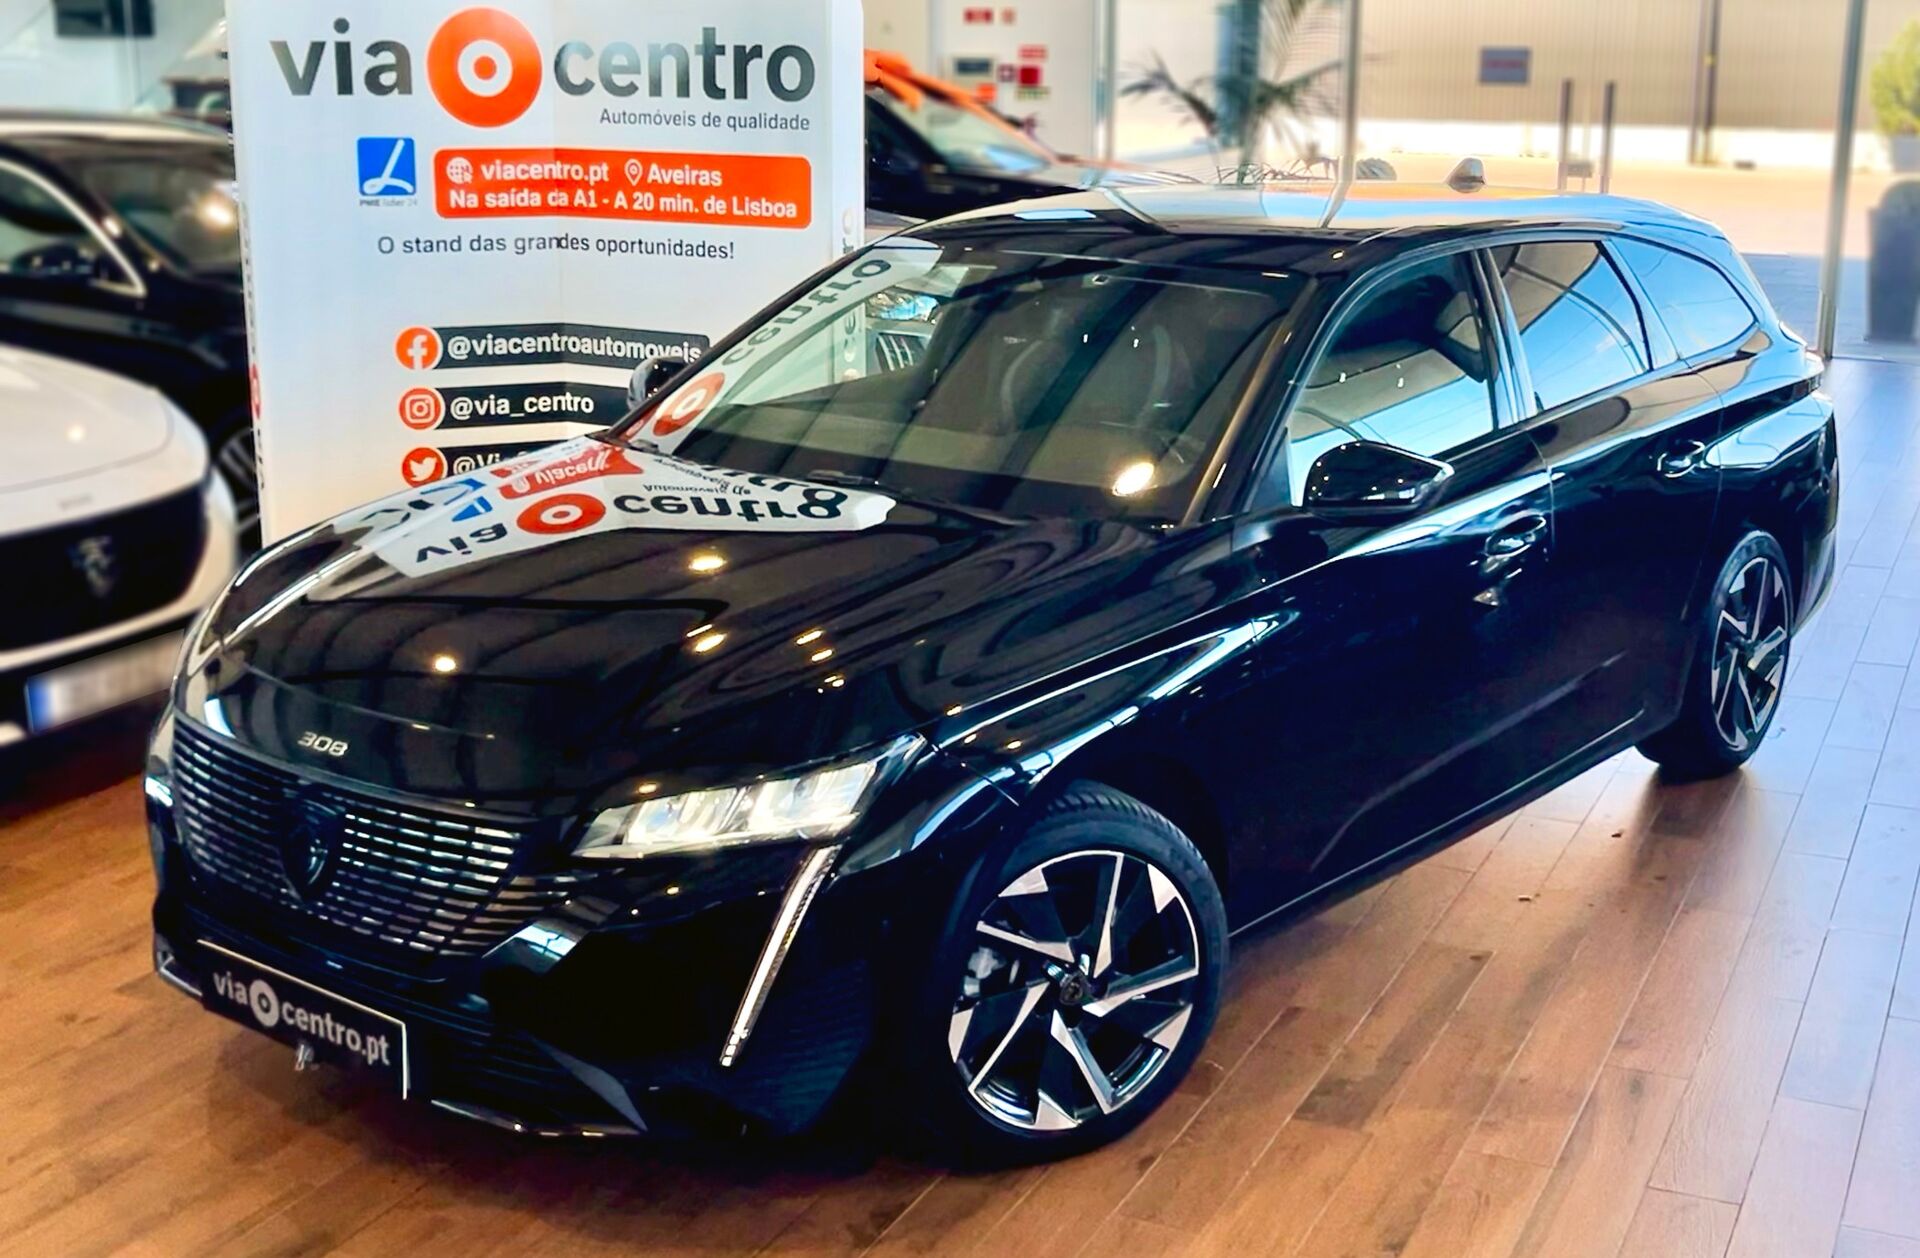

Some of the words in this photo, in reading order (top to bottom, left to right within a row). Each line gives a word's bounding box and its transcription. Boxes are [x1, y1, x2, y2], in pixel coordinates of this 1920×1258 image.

[271, 17, 413, 97] via
[553, 26, 817, 102] centro
[600, 108, 696, 128] Automóveis
[701, 111, 721, 128] de
[726, 112, 810, 132] qualidade
[480, 160, 609, 186] viacentro.pt
[646, 163, 723, 187] Aveiras
[449, 190, 479, 209] Na
[484, 188, 542, 209] saída
[547, 189, 570, 208] da
[573, 189, 598, 209] A1
[613, 190, 628, 210] A
[632, 191, 655, 211] 20
[659, 193, 699, 213] min.
[703, 196, 727, 215] de
[732, 197, 797, 218] Lisboa
[377, 236, 395, 254] O
[402, 235, 462, 254] stand
[469, 235, 507, 251] das
[514, 233, 590, 255] grandes
[595, 238, 735, 259] oportunidades!
[447, 332, 703, 364] @viacentroautomoveis
[450, 391, 595, 421] @via_centro
[297, 731, 348, 757] 308
[213, 971, 249, 1004] via
[281, 1001, 390, 1066] centro.pt
